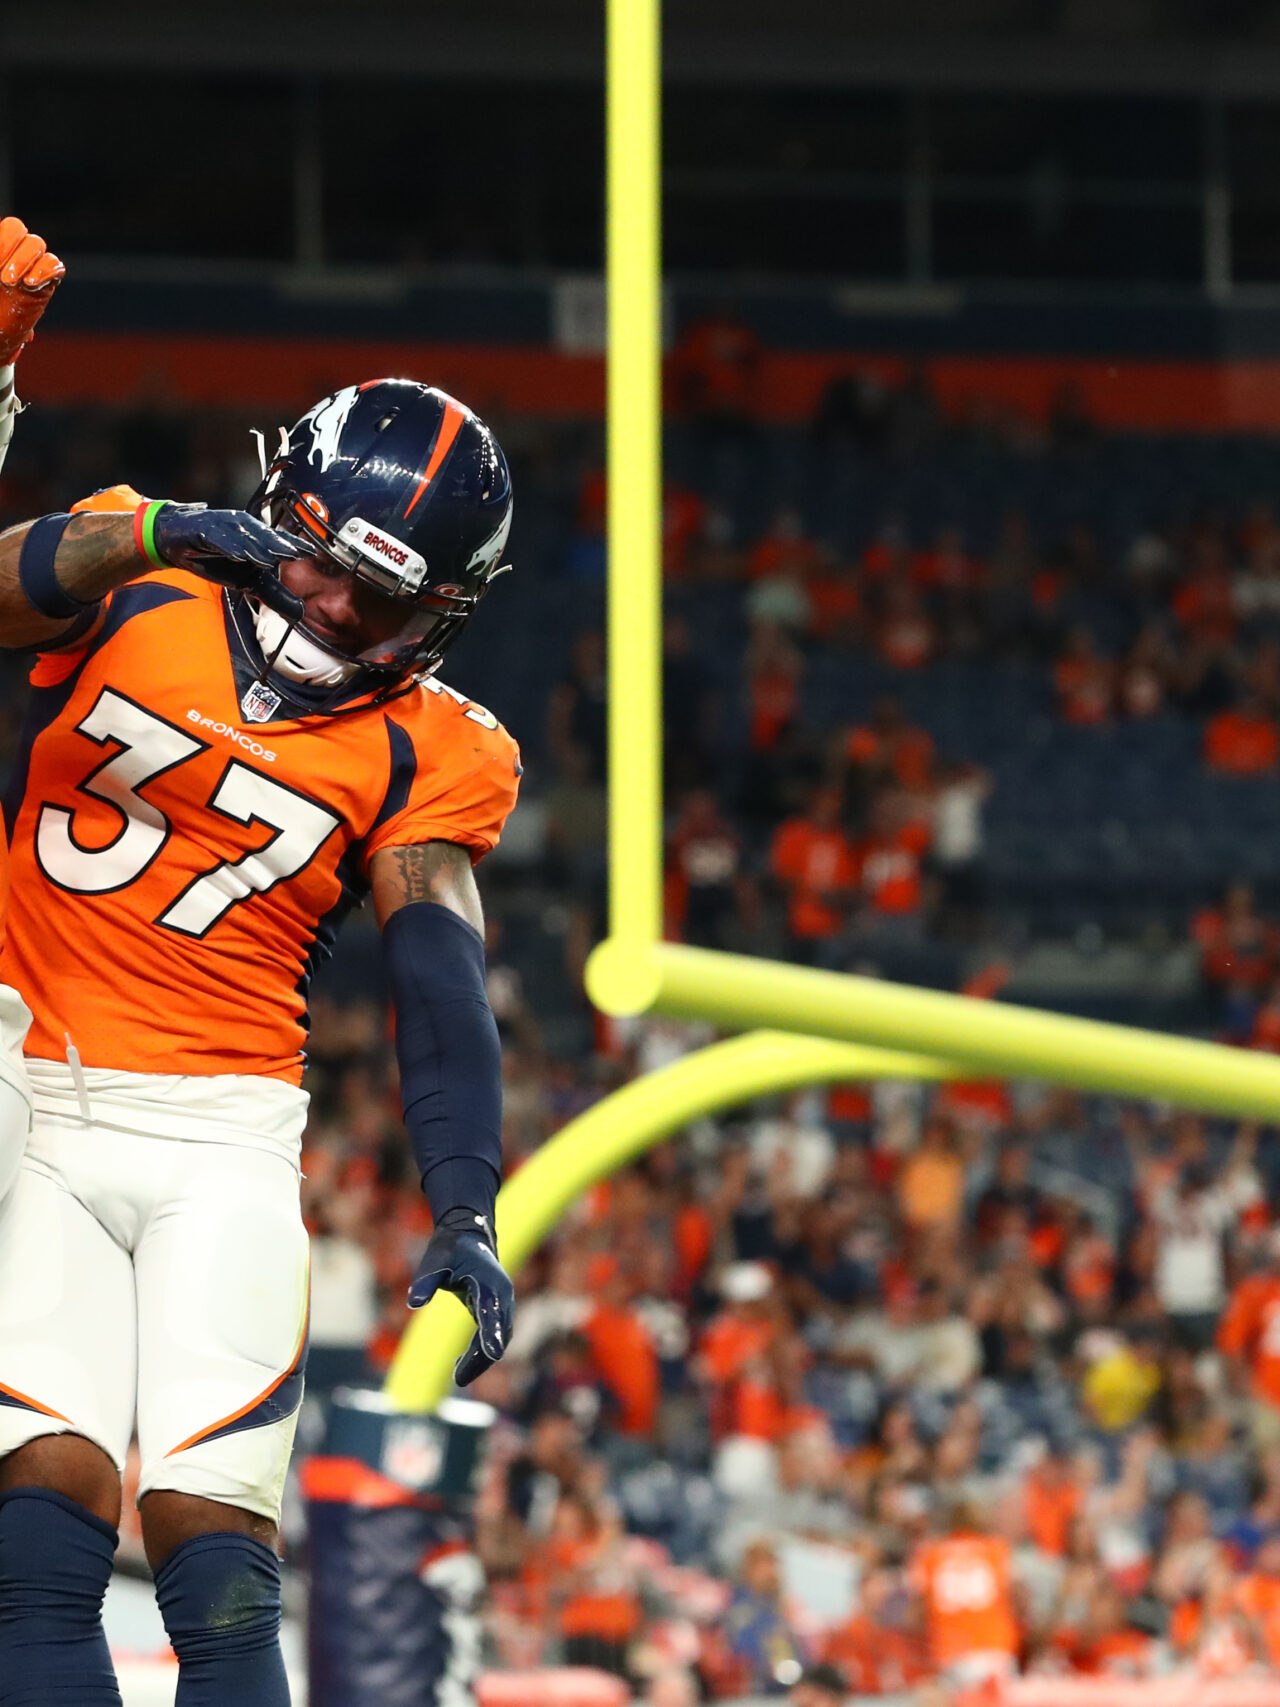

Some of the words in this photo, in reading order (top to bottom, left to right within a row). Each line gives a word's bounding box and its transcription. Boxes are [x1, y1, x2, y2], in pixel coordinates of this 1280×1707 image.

[363, 531, 408, 565] BRONCOS
[246, 696, 270, 718] NFL
[186, 709, 277, 762] BRONCOS
[34, 685, 345, 941] 37
